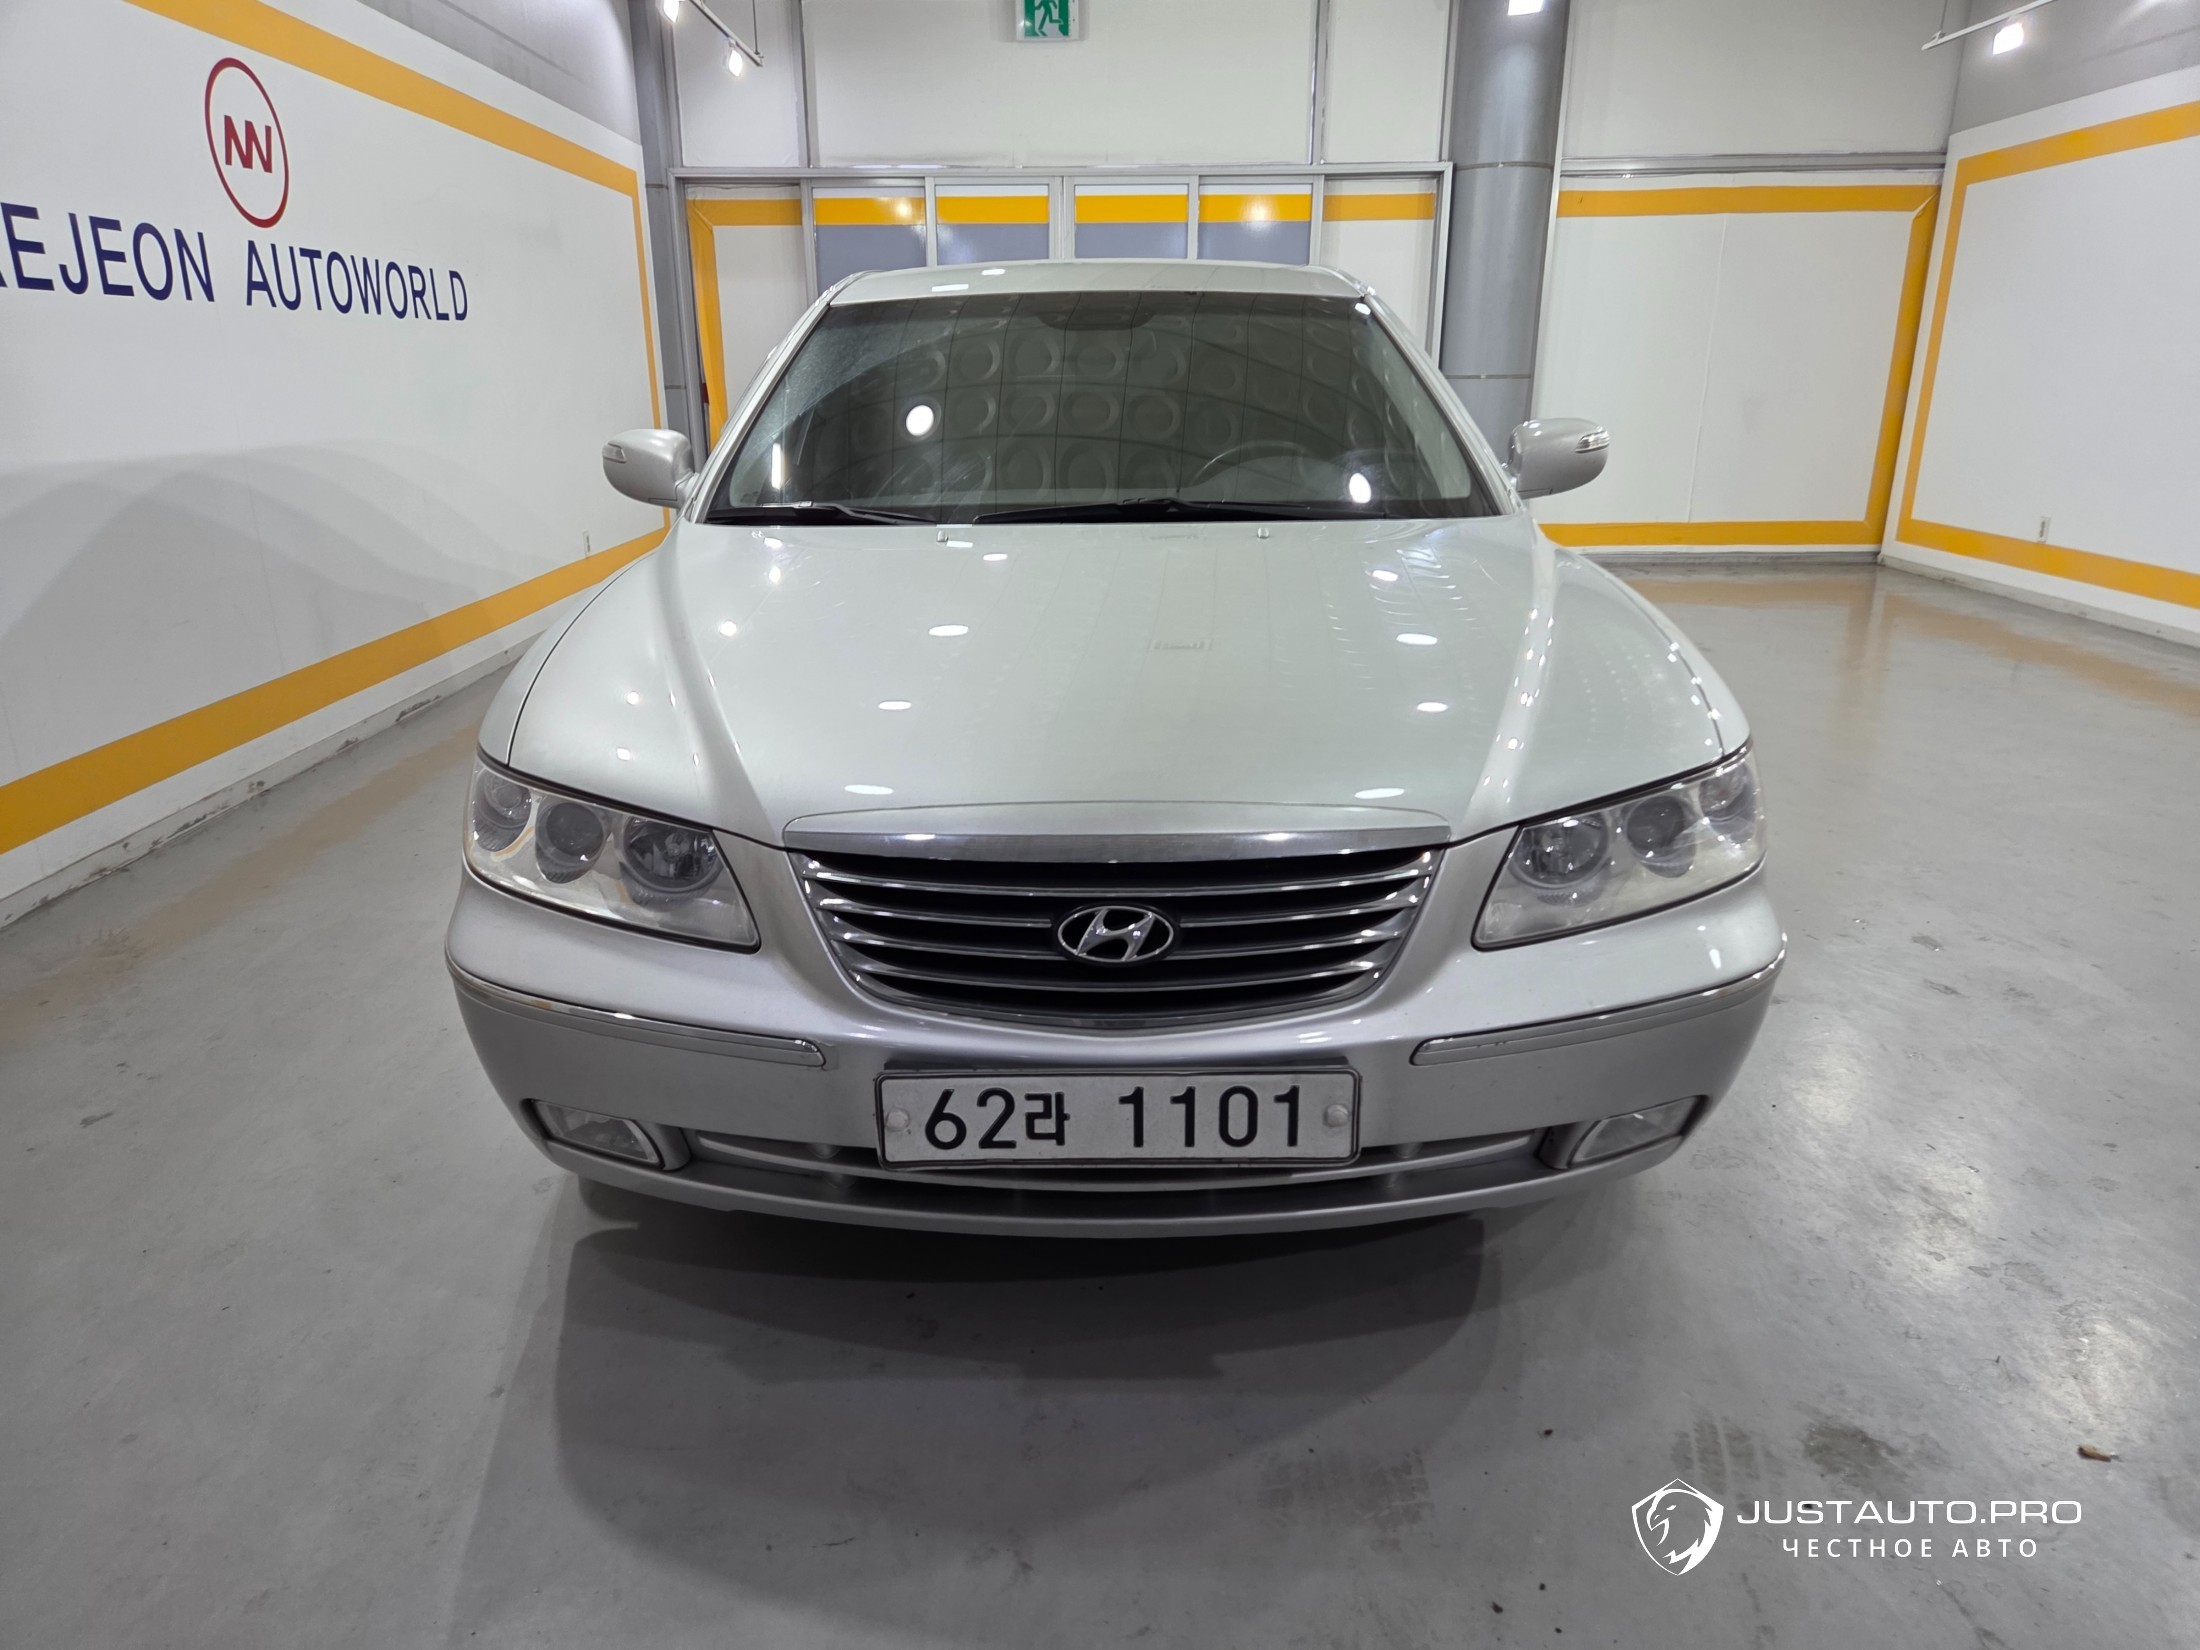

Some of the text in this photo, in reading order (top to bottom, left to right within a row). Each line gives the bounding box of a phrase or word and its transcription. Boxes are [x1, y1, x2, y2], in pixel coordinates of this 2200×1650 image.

[0, 202, 468, 321] EJEON AUTOWORLD
[924, 1085, 1301, 1150] 62라 1101
